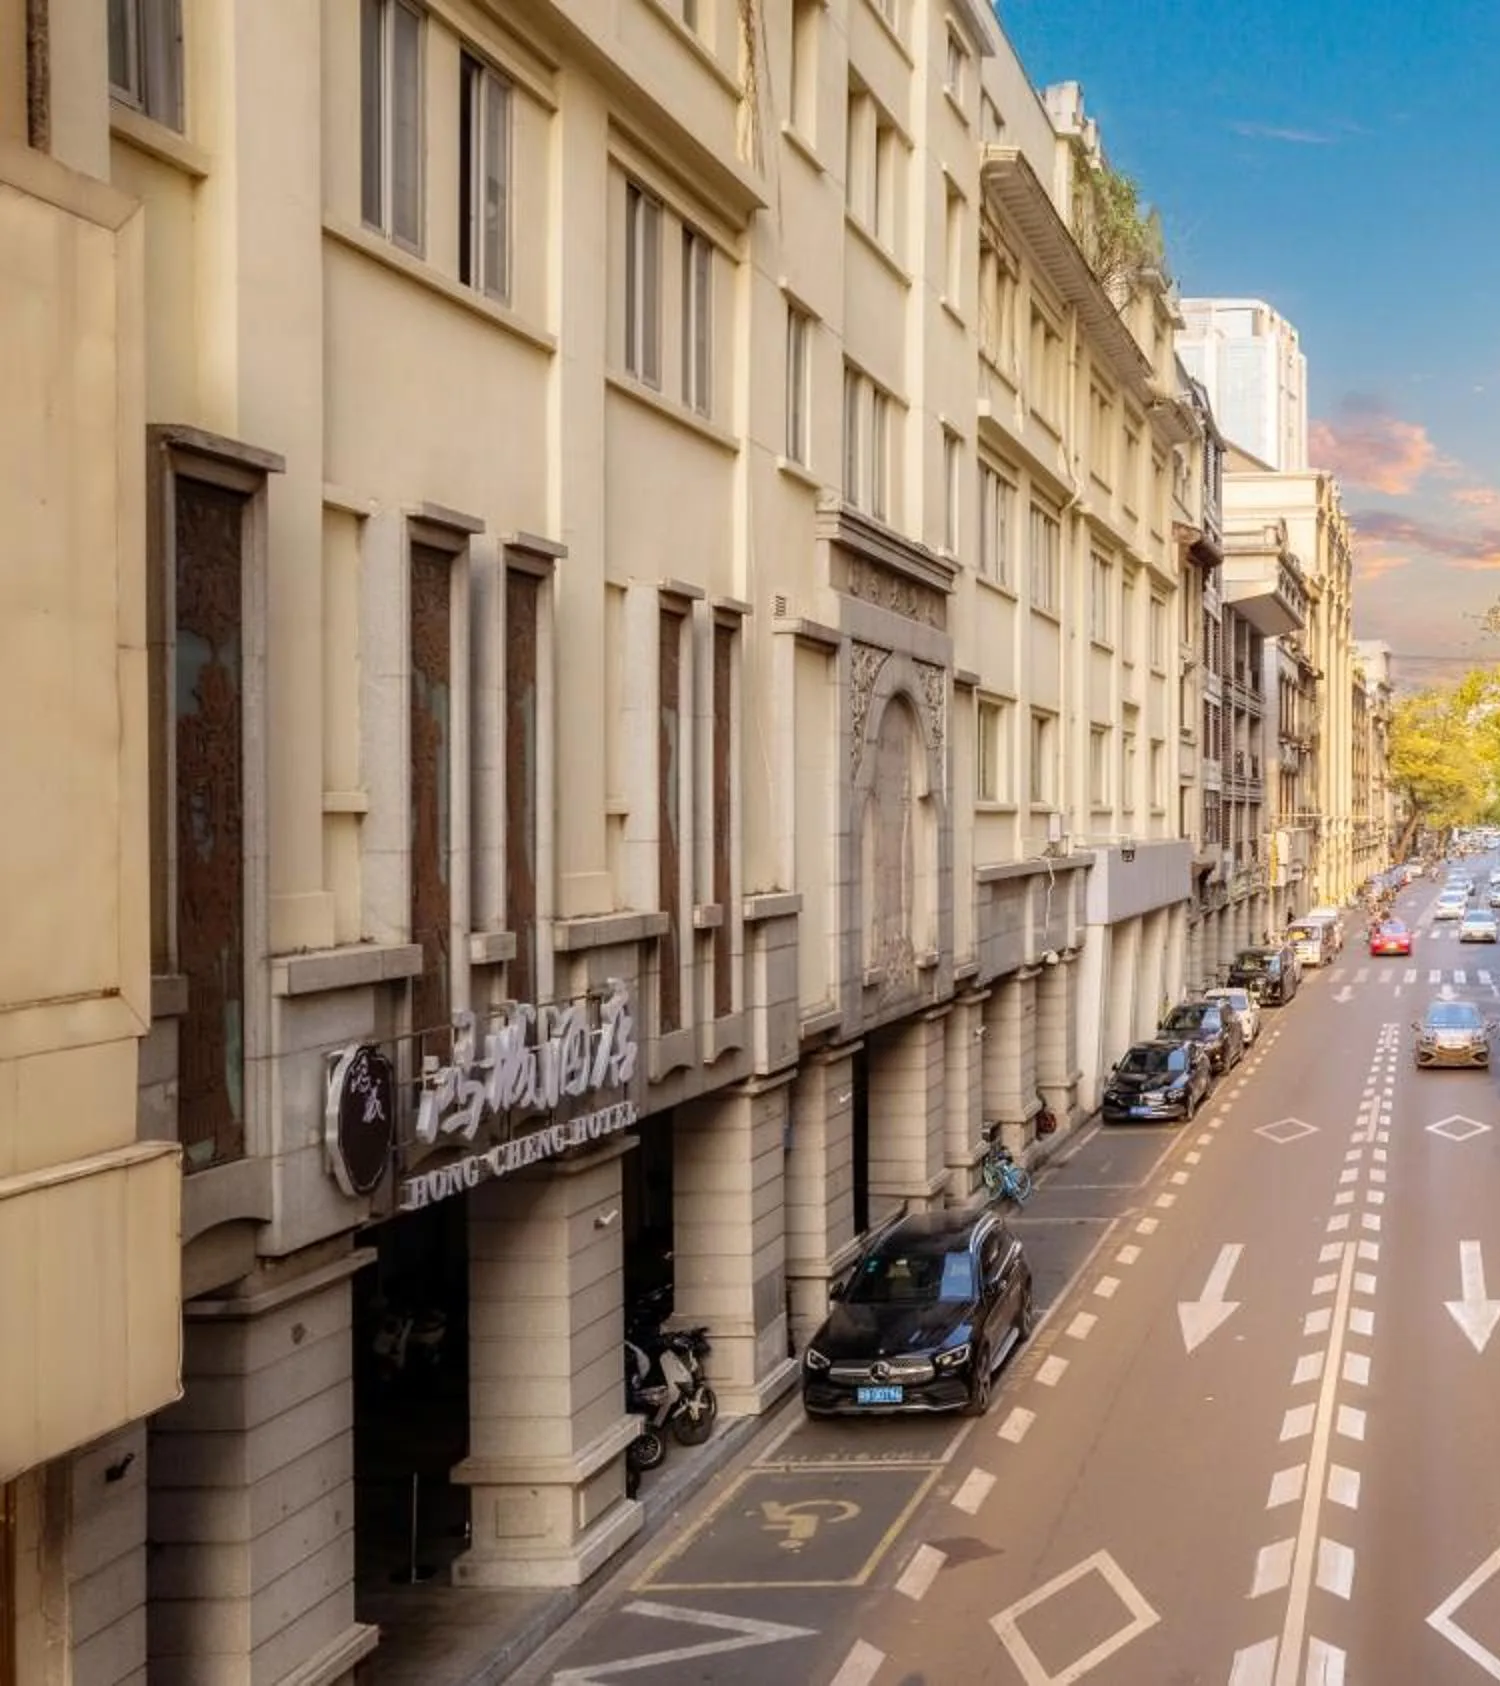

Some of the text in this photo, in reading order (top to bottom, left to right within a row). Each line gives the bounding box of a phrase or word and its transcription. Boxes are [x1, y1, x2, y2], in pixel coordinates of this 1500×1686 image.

[408, 1101, 639, 1209] HONG CHENG HOTEL
